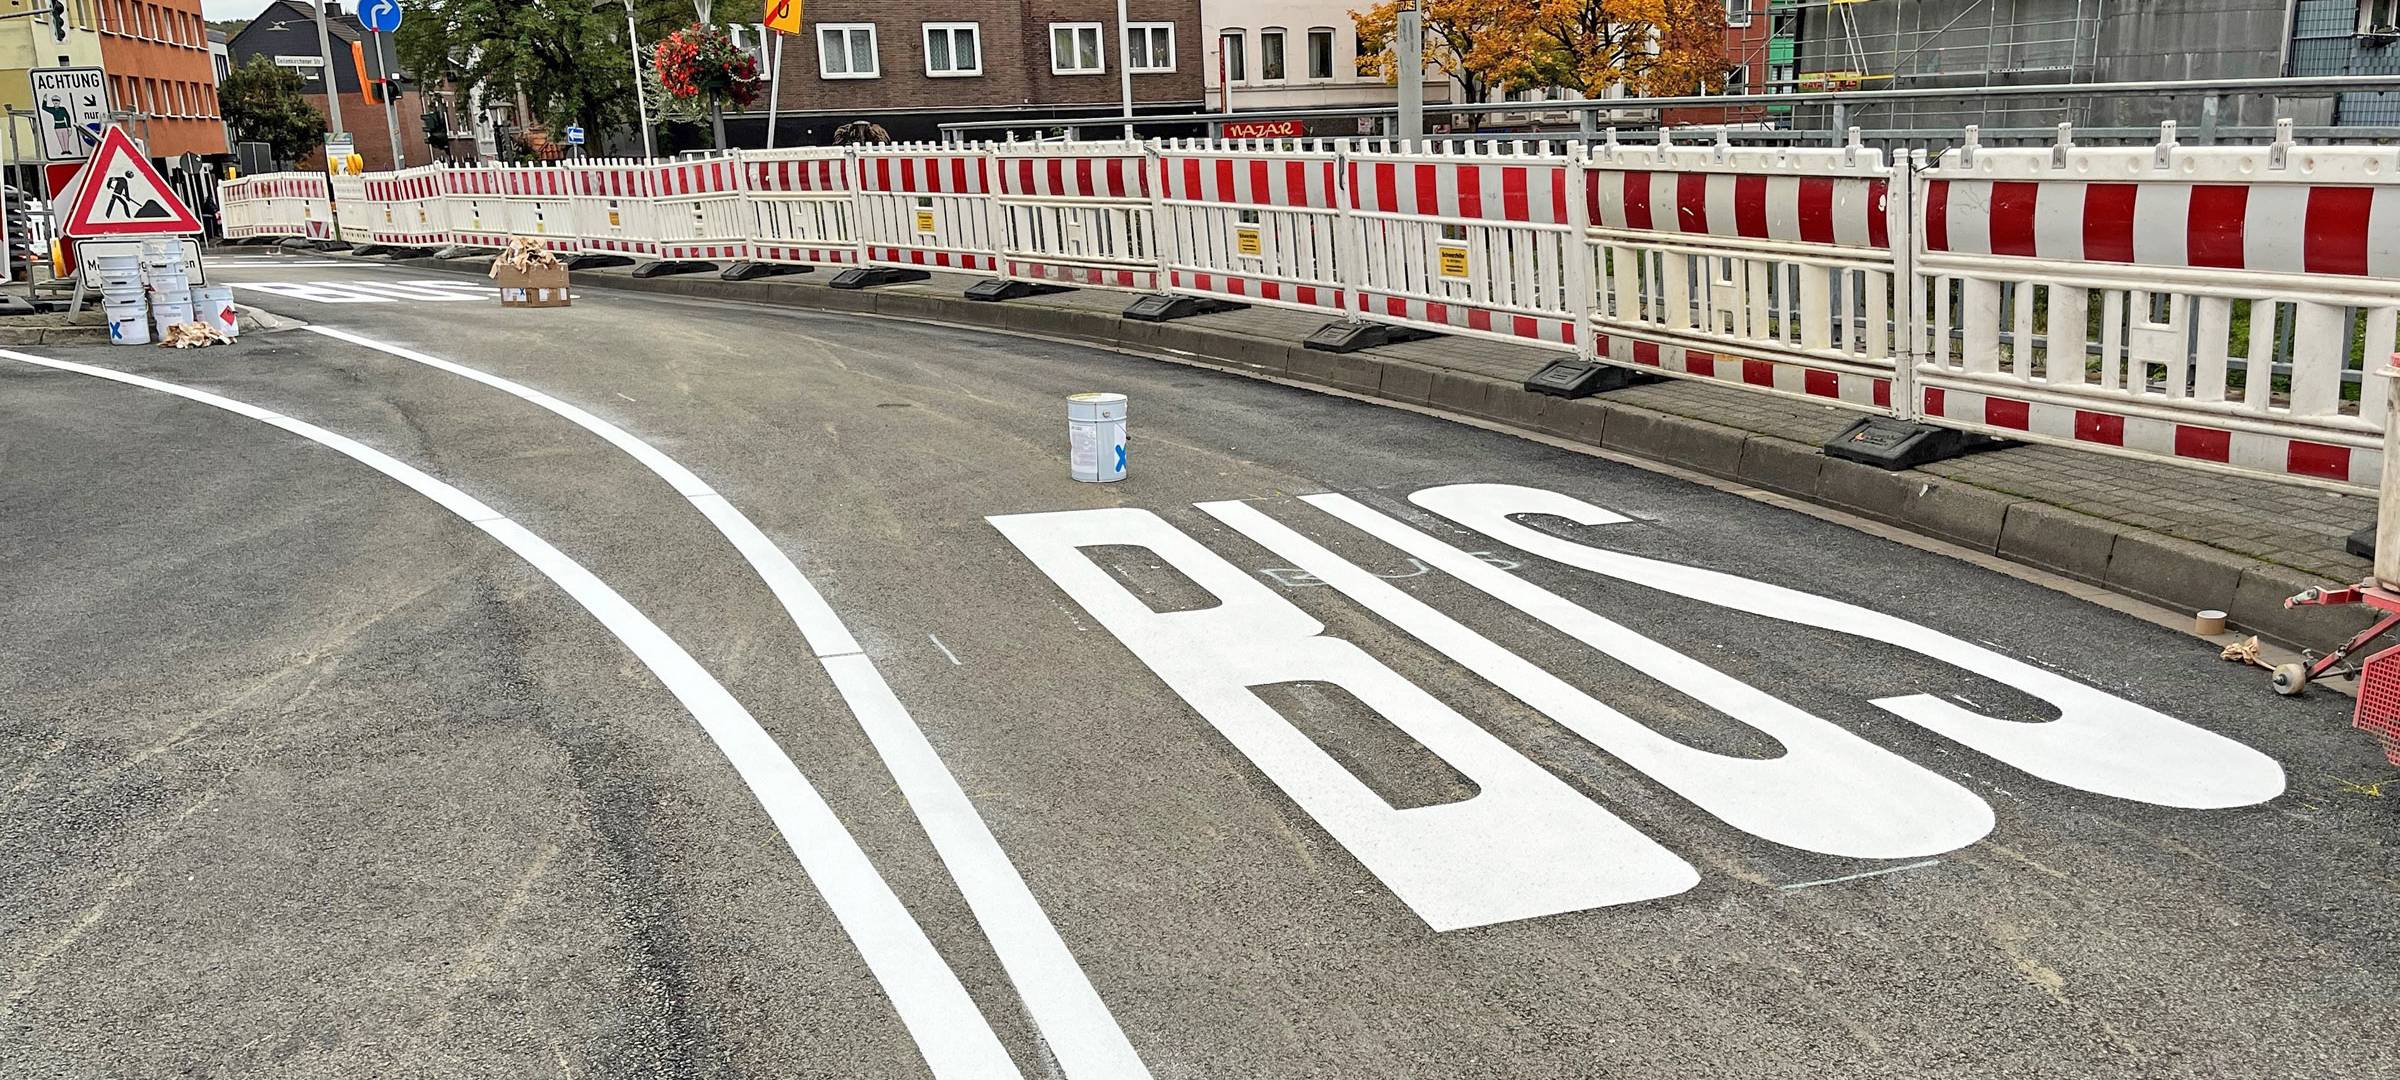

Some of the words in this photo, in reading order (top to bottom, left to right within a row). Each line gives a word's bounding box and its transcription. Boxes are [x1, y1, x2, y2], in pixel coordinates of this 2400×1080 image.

[38, 73, 100, 90] ACHTUNG
[84, 111, 99, 120] nur
[1229, 122, 1294, 138] NAZAR
[984, 483, 2287, 932] BUS
